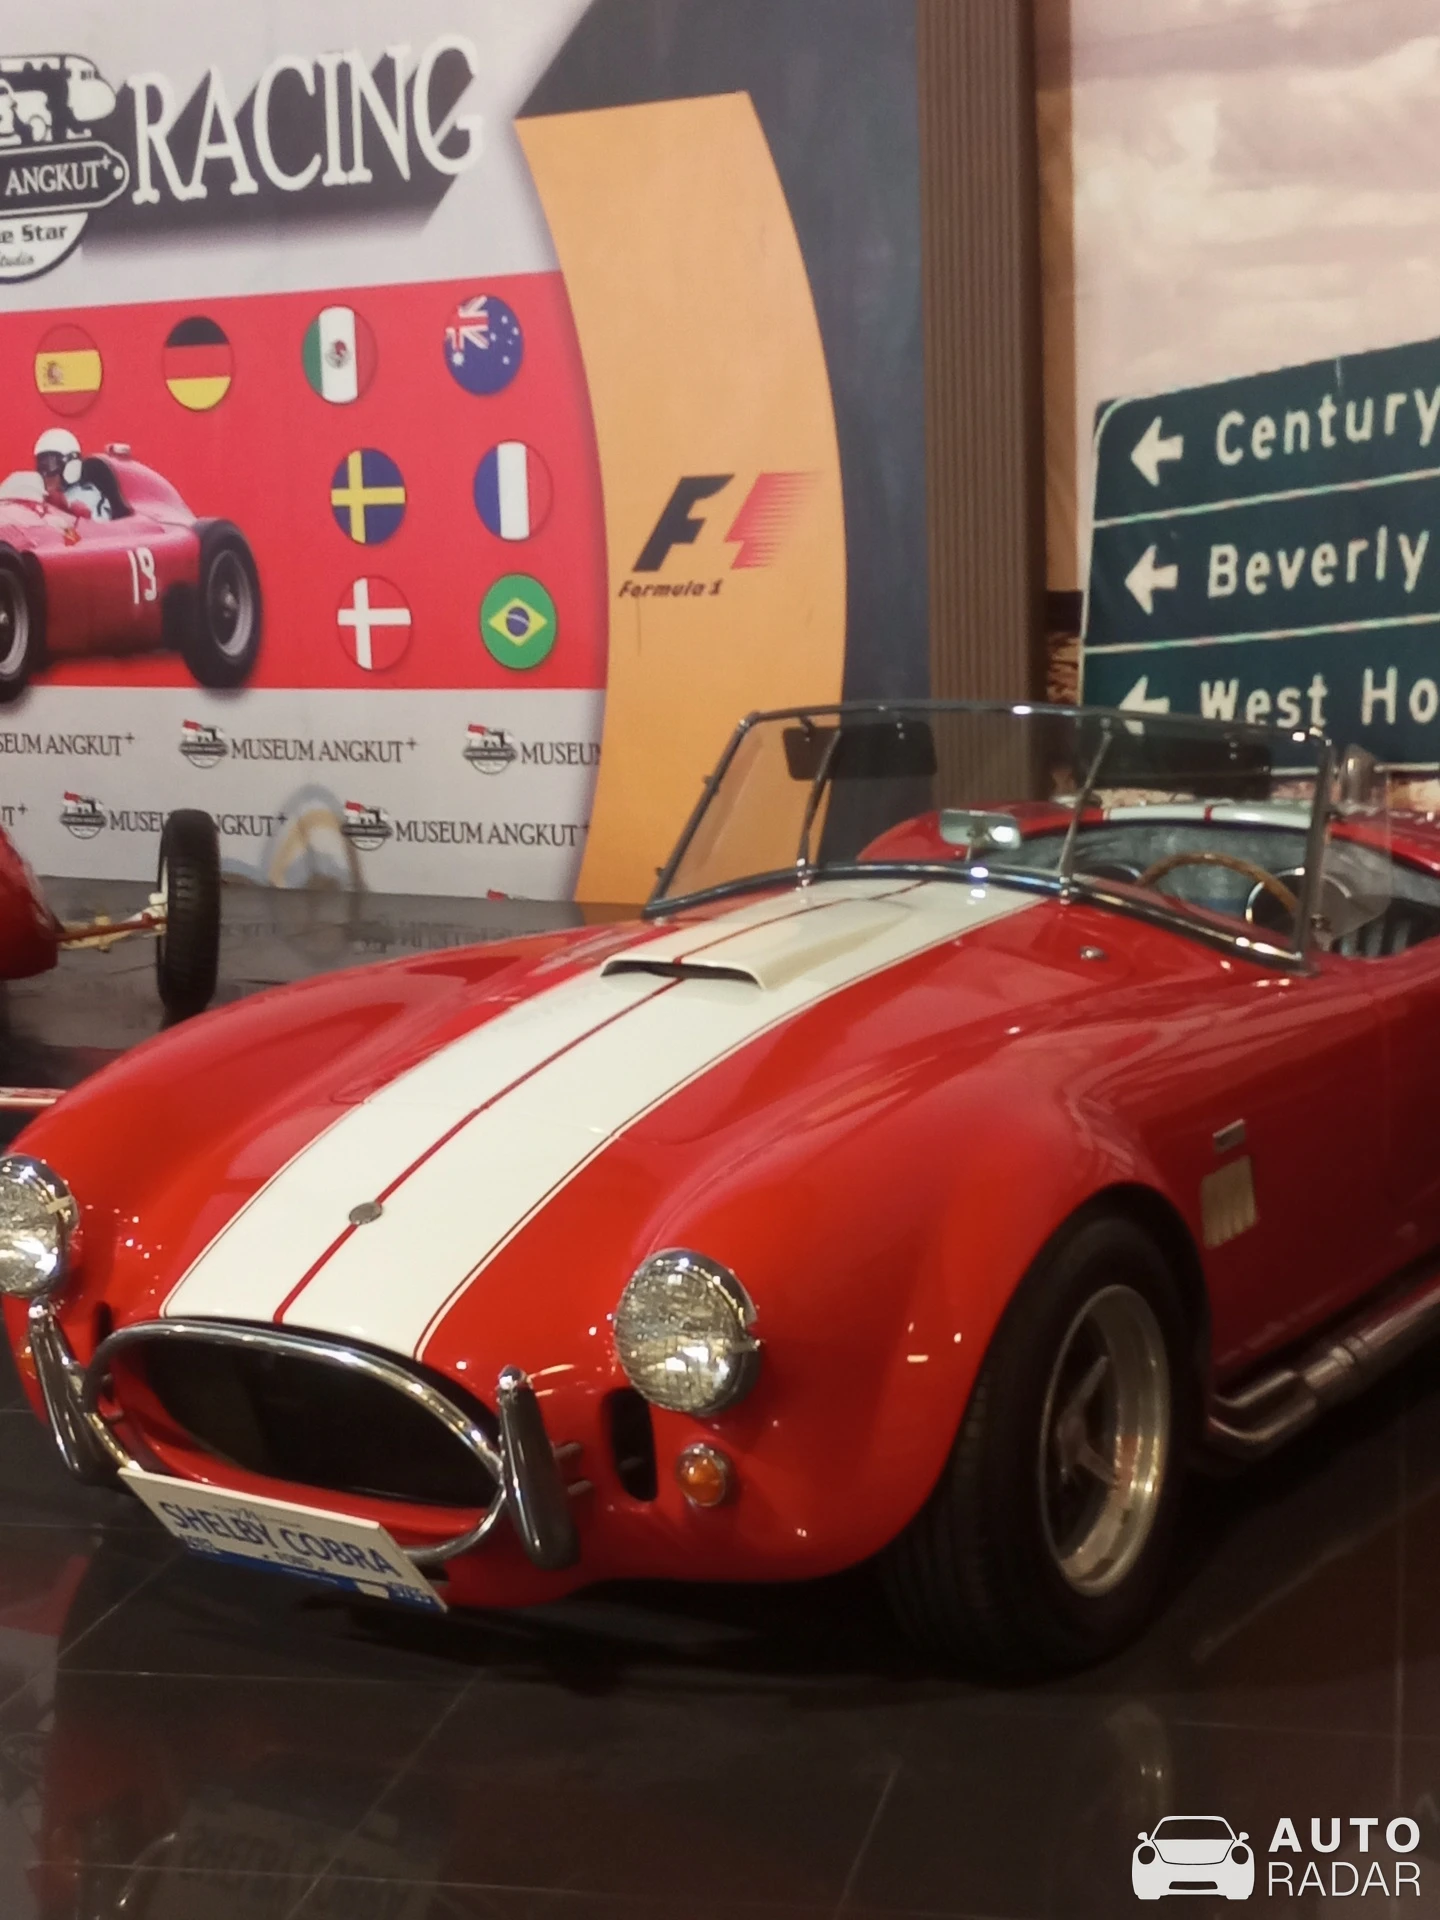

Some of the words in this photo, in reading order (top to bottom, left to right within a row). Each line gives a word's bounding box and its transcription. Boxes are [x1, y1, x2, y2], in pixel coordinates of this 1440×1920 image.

[127, 34, 486, 205] RACING
[21, 225, 68, 242] Star
[1216, 384, 1440, 466] Century
[127, 547, 157, 605] 19
[618, 580, 706, 598] Formula
[1208, 525, 1430, 598] Beverly
[1200, 672, 1328, 728] West
[1361, 665, 1438, 725] Ho
[230, 738, 316, 761] MUSEUM
[395, 819, 484, 845] MUSEUM
[158, 1501, 279, 1549] SHELBY
[279, 1527, 402, 1578] COBRA
